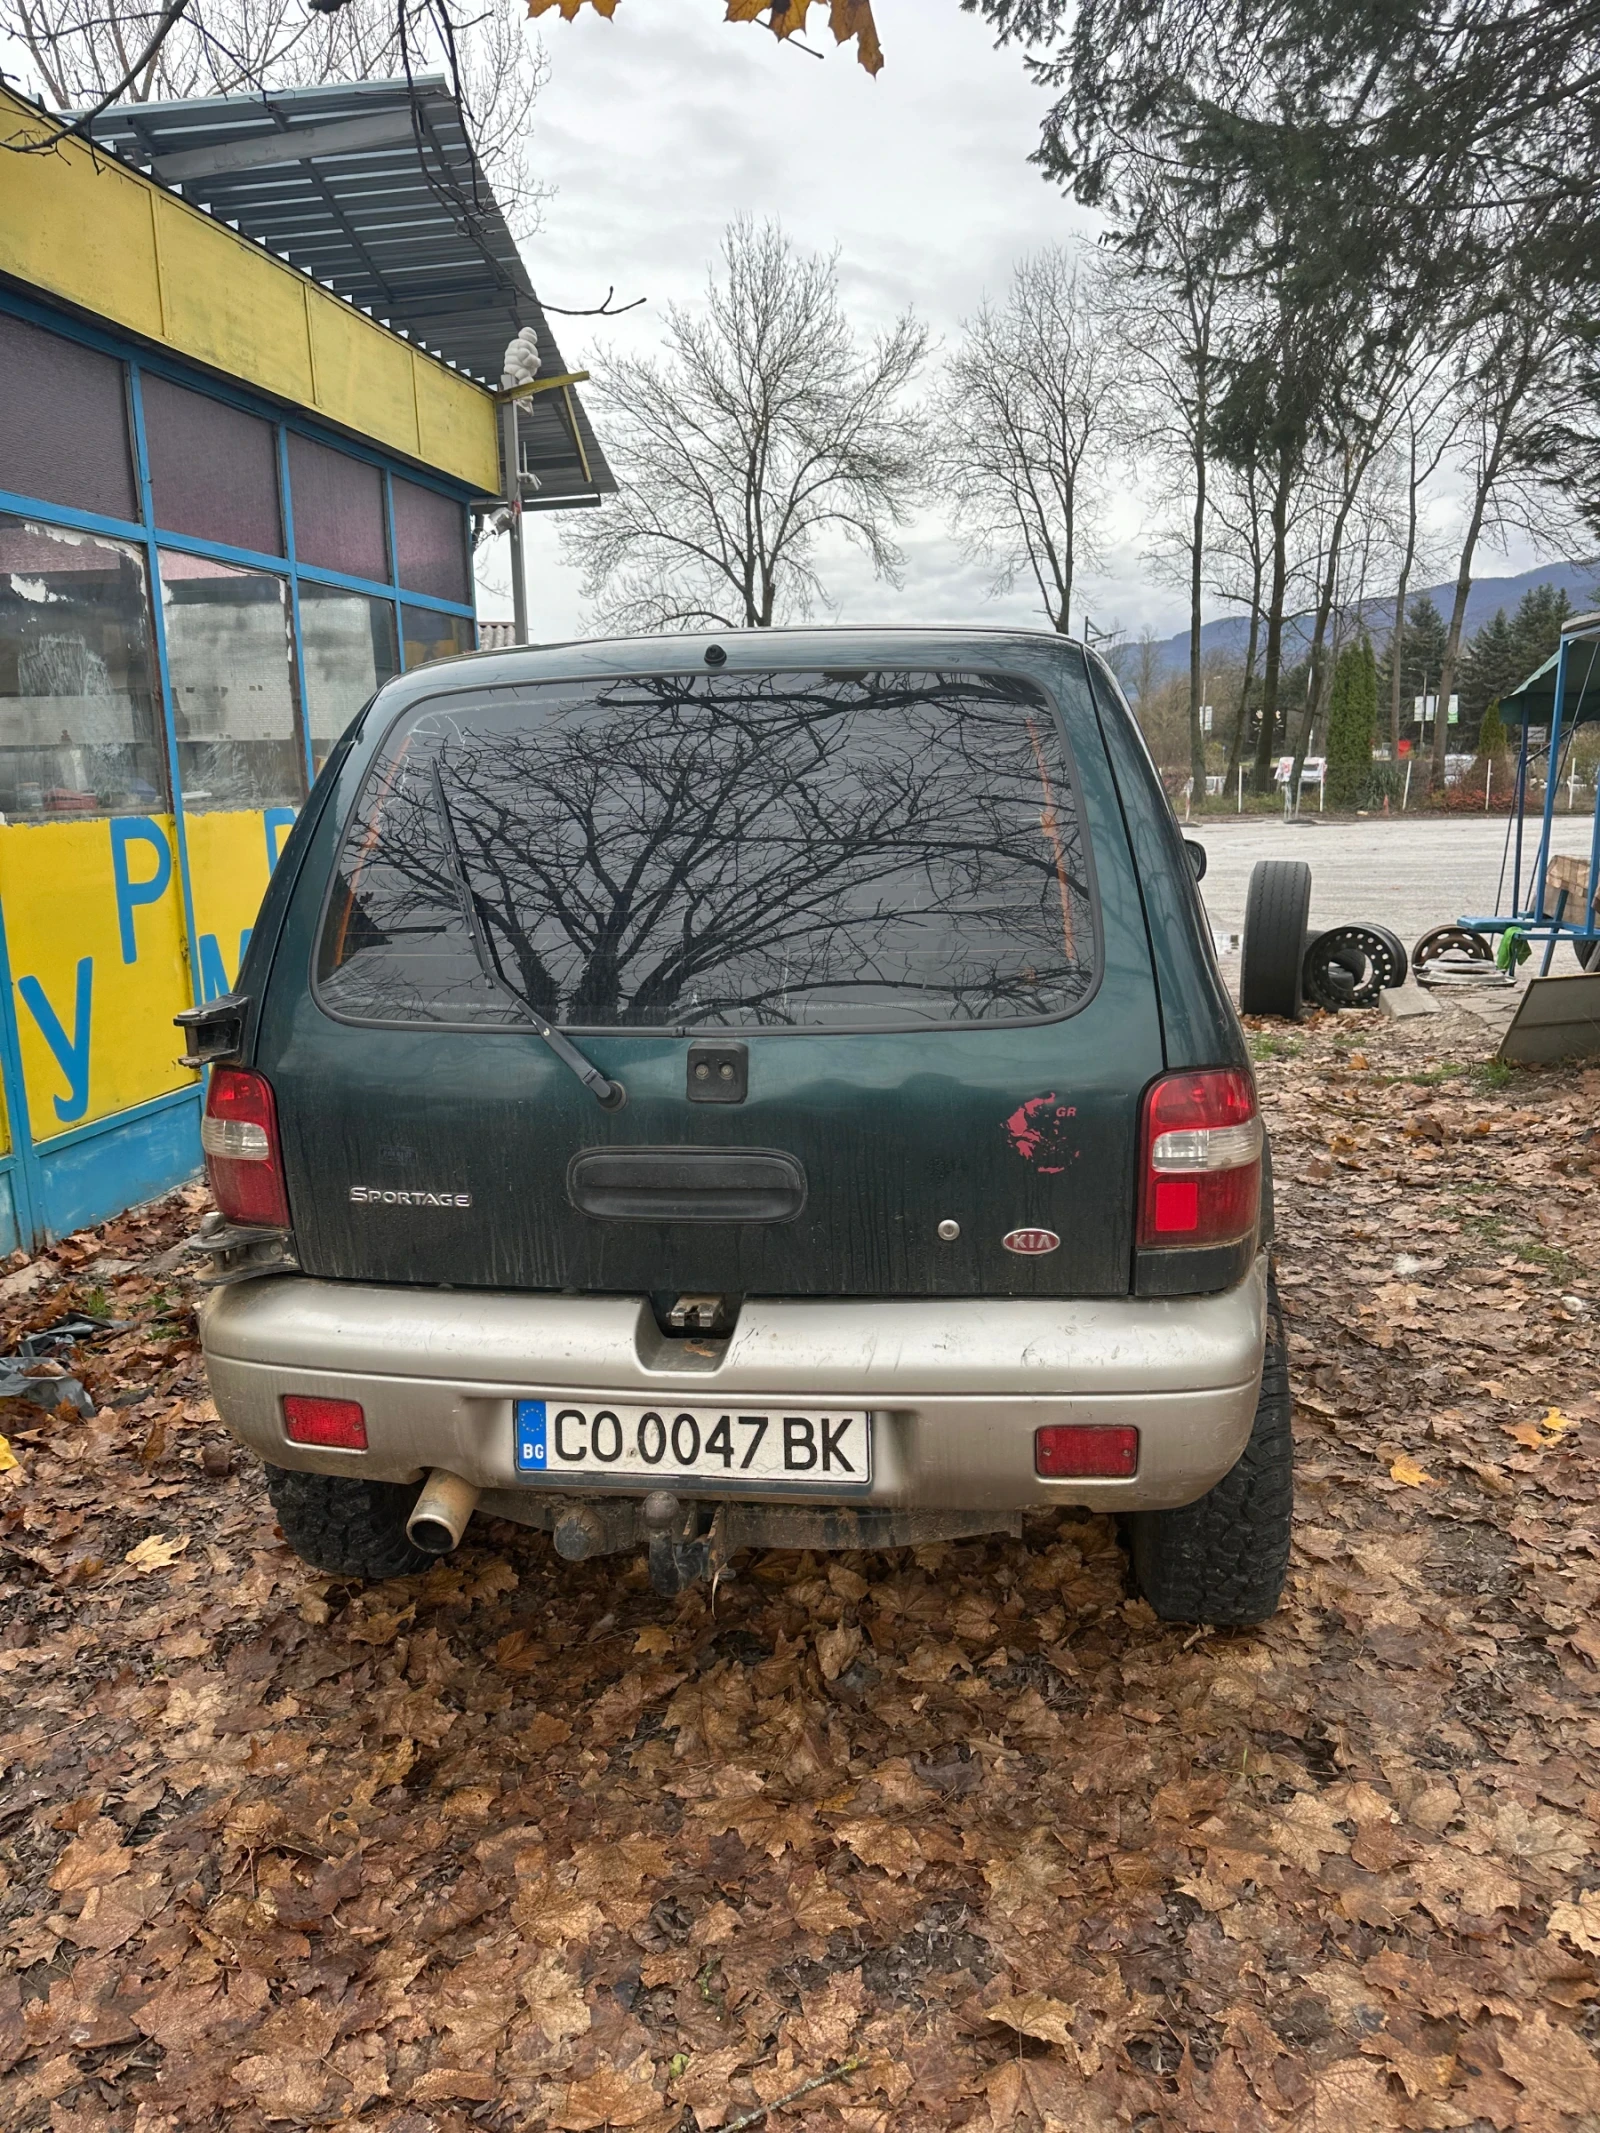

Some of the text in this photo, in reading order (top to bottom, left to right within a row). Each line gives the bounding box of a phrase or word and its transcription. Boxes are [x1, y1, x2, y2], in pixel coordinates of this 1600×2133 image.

[1056, 1106, 1077, 1117] GR
[350, 1187, 470, 1207] SPORTAGE
[1013, 1234, 1051, 1249] KIA
[554, 1410, 855, 1473] CO 0047 BK
[523, 1443, 544, 1460] BG
